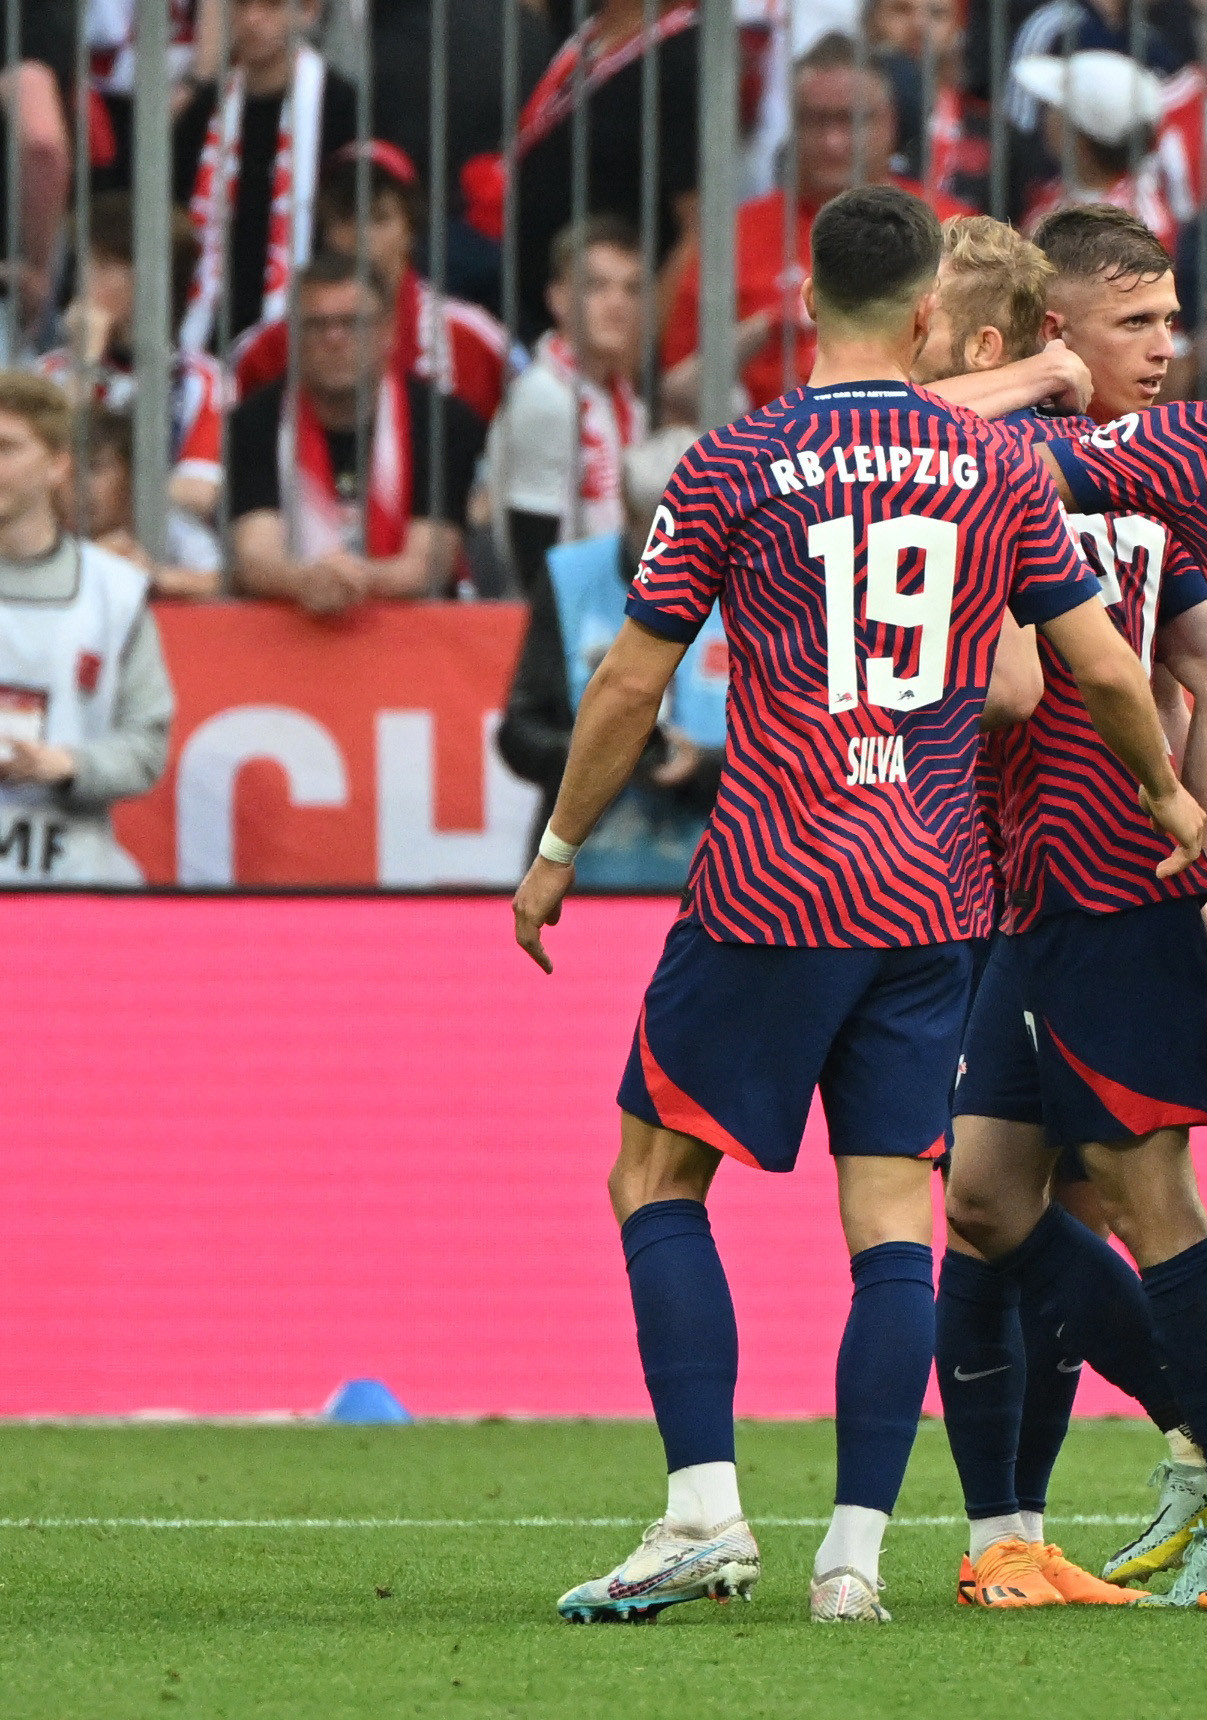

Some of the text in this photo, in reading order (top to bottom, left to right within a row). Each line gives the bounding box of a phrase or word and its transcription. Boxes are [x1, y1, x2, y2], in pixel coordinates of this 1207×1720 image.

[769, 444, 979, 496] RB LEIPZIG
[807, 513, 958, 715] 19
[846, 735, 907, 787] SILVA
